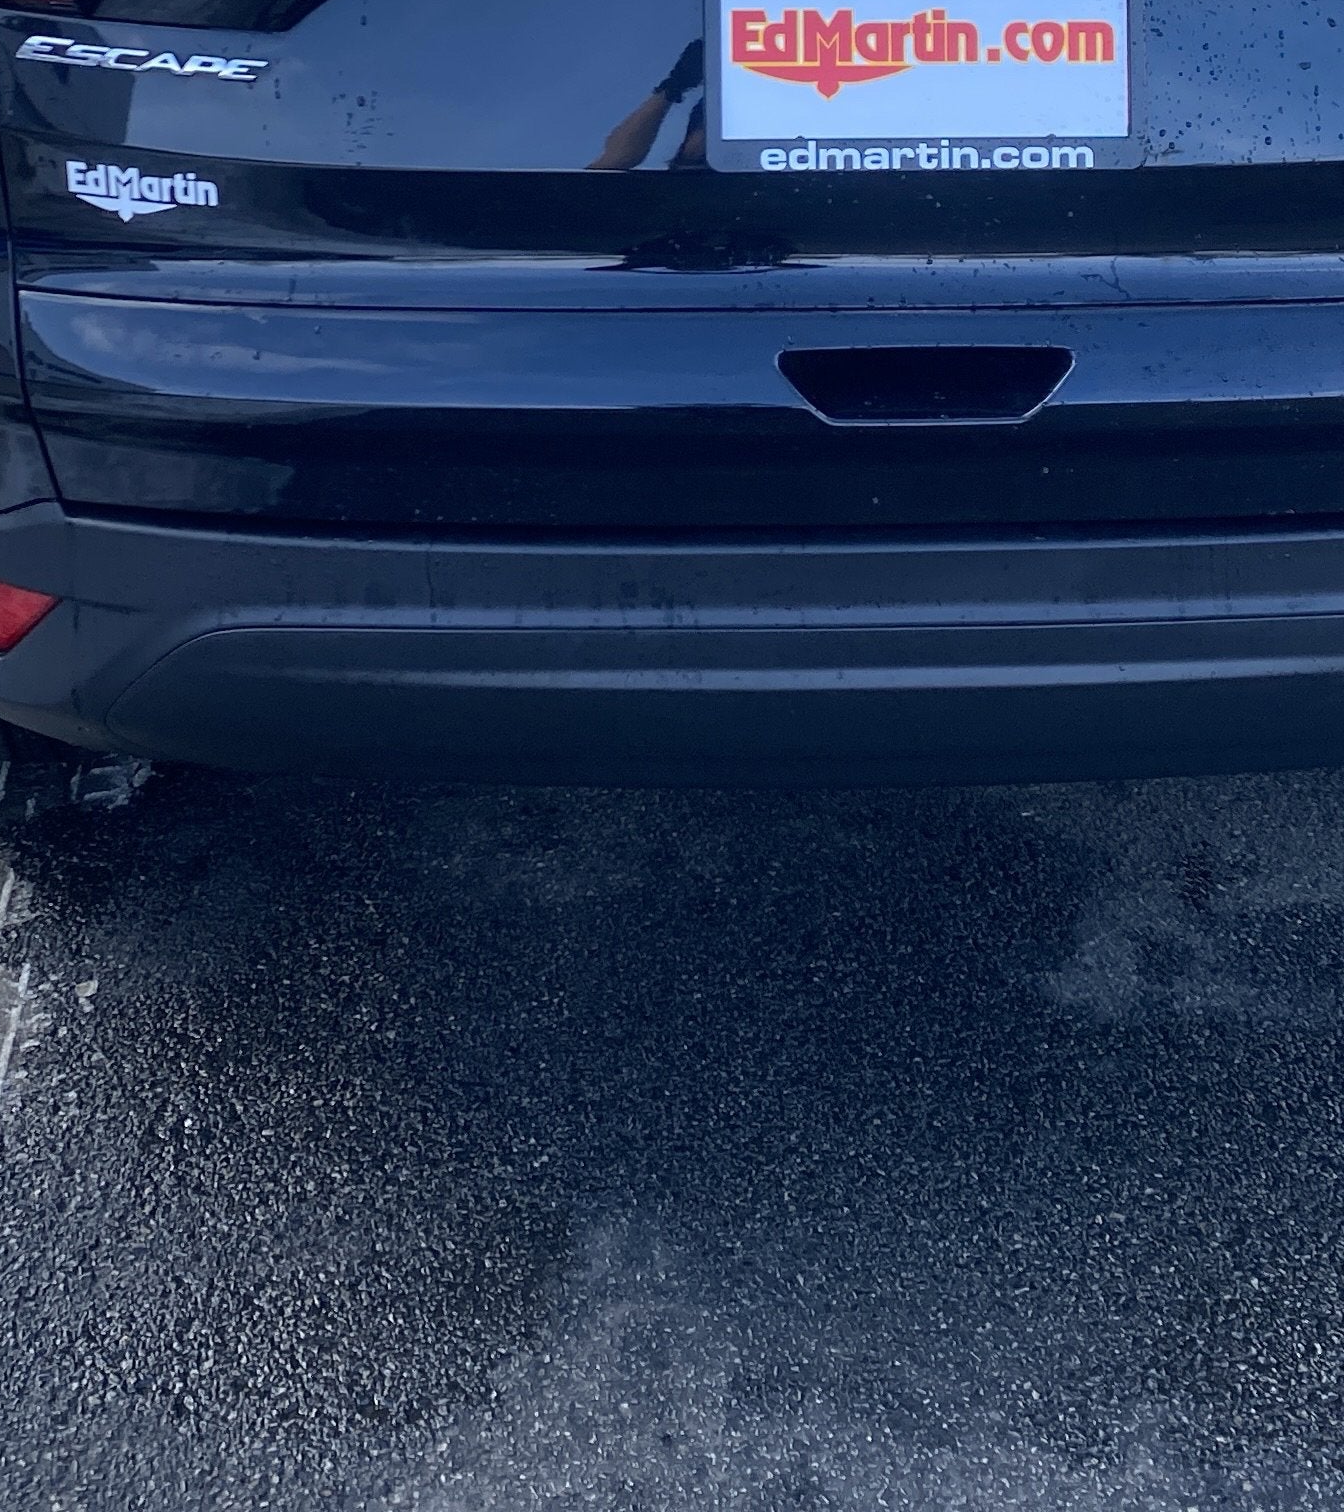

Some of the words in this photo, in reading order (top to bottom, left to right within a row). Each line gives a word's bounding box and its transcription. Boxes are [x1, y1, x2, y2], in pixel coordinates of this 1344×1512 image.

[15, 35, 269, 81] ESCAPE
[730, 8, 1116, 66] EdMartin.com
[759, 139, 1095, 171] edmartin.com
[66, 160, 219, 207] EdMartin
